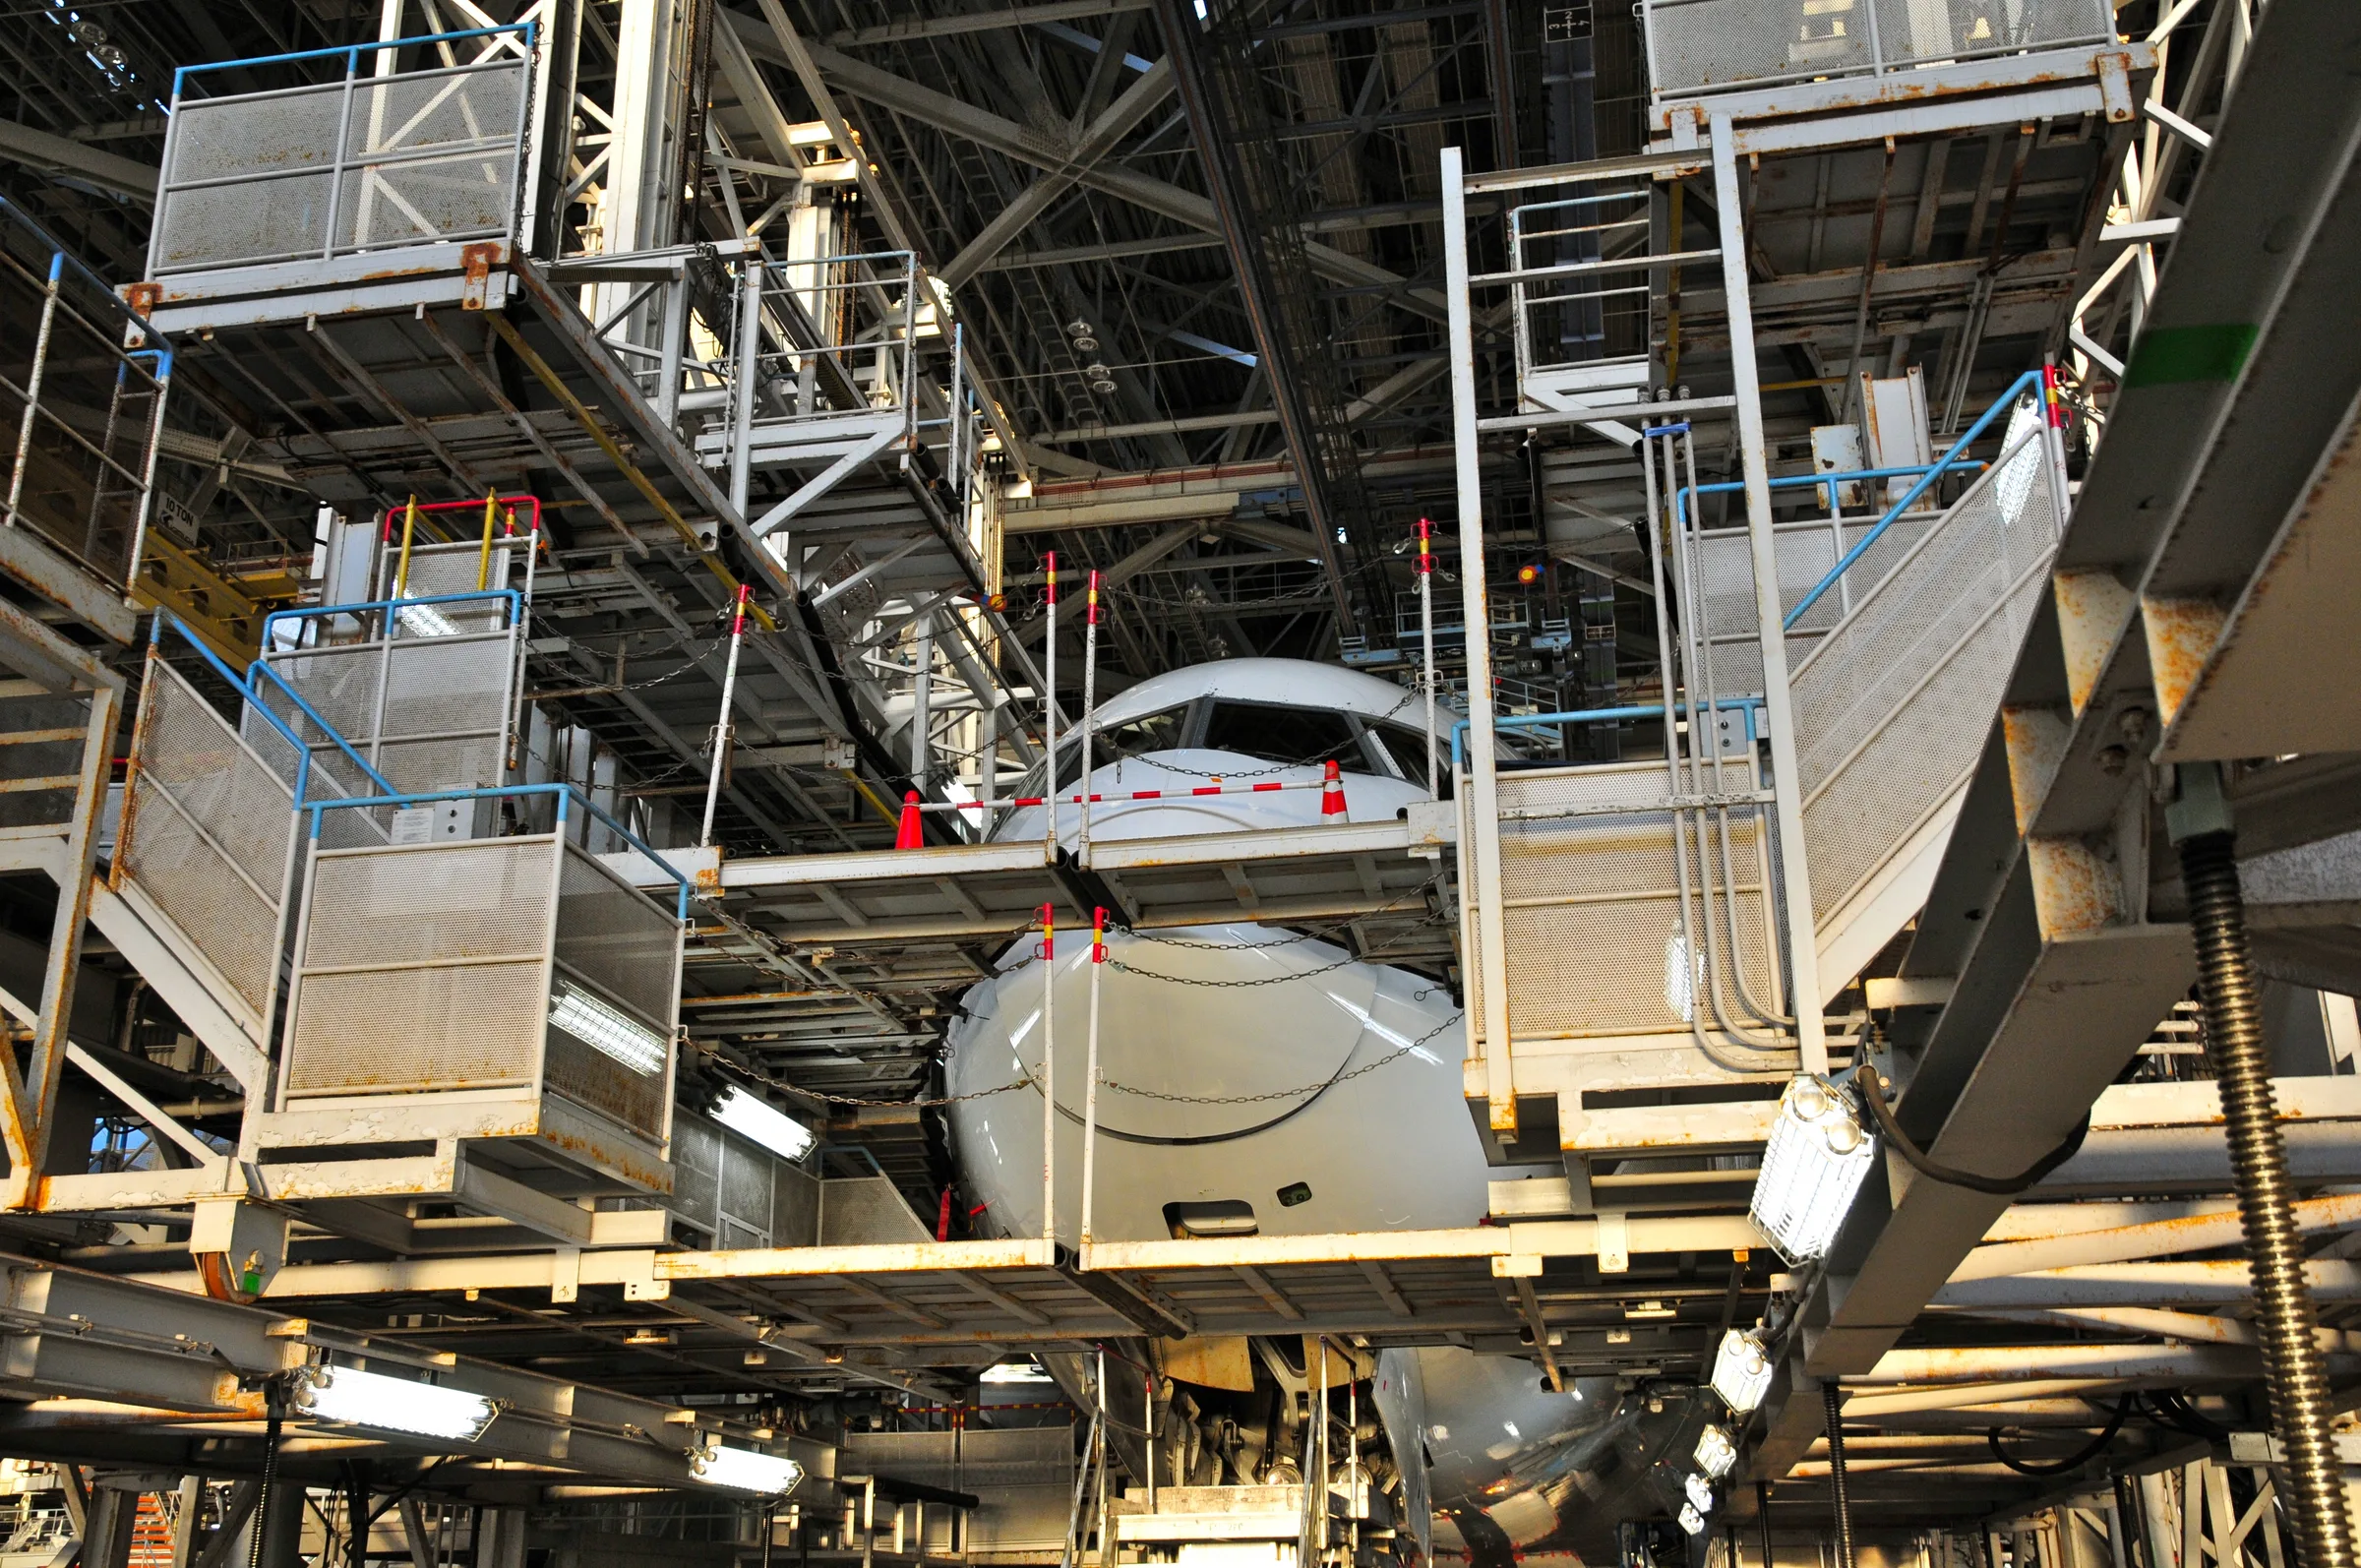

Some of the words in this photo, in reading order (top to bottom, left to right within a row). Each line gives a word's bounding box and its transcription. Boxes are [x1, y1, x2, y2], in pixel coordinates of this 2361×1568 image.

[1564, 11, 1573, 20] 2
[165, 497, 175, 513] 10
[176, 504, 194, 526] TON
